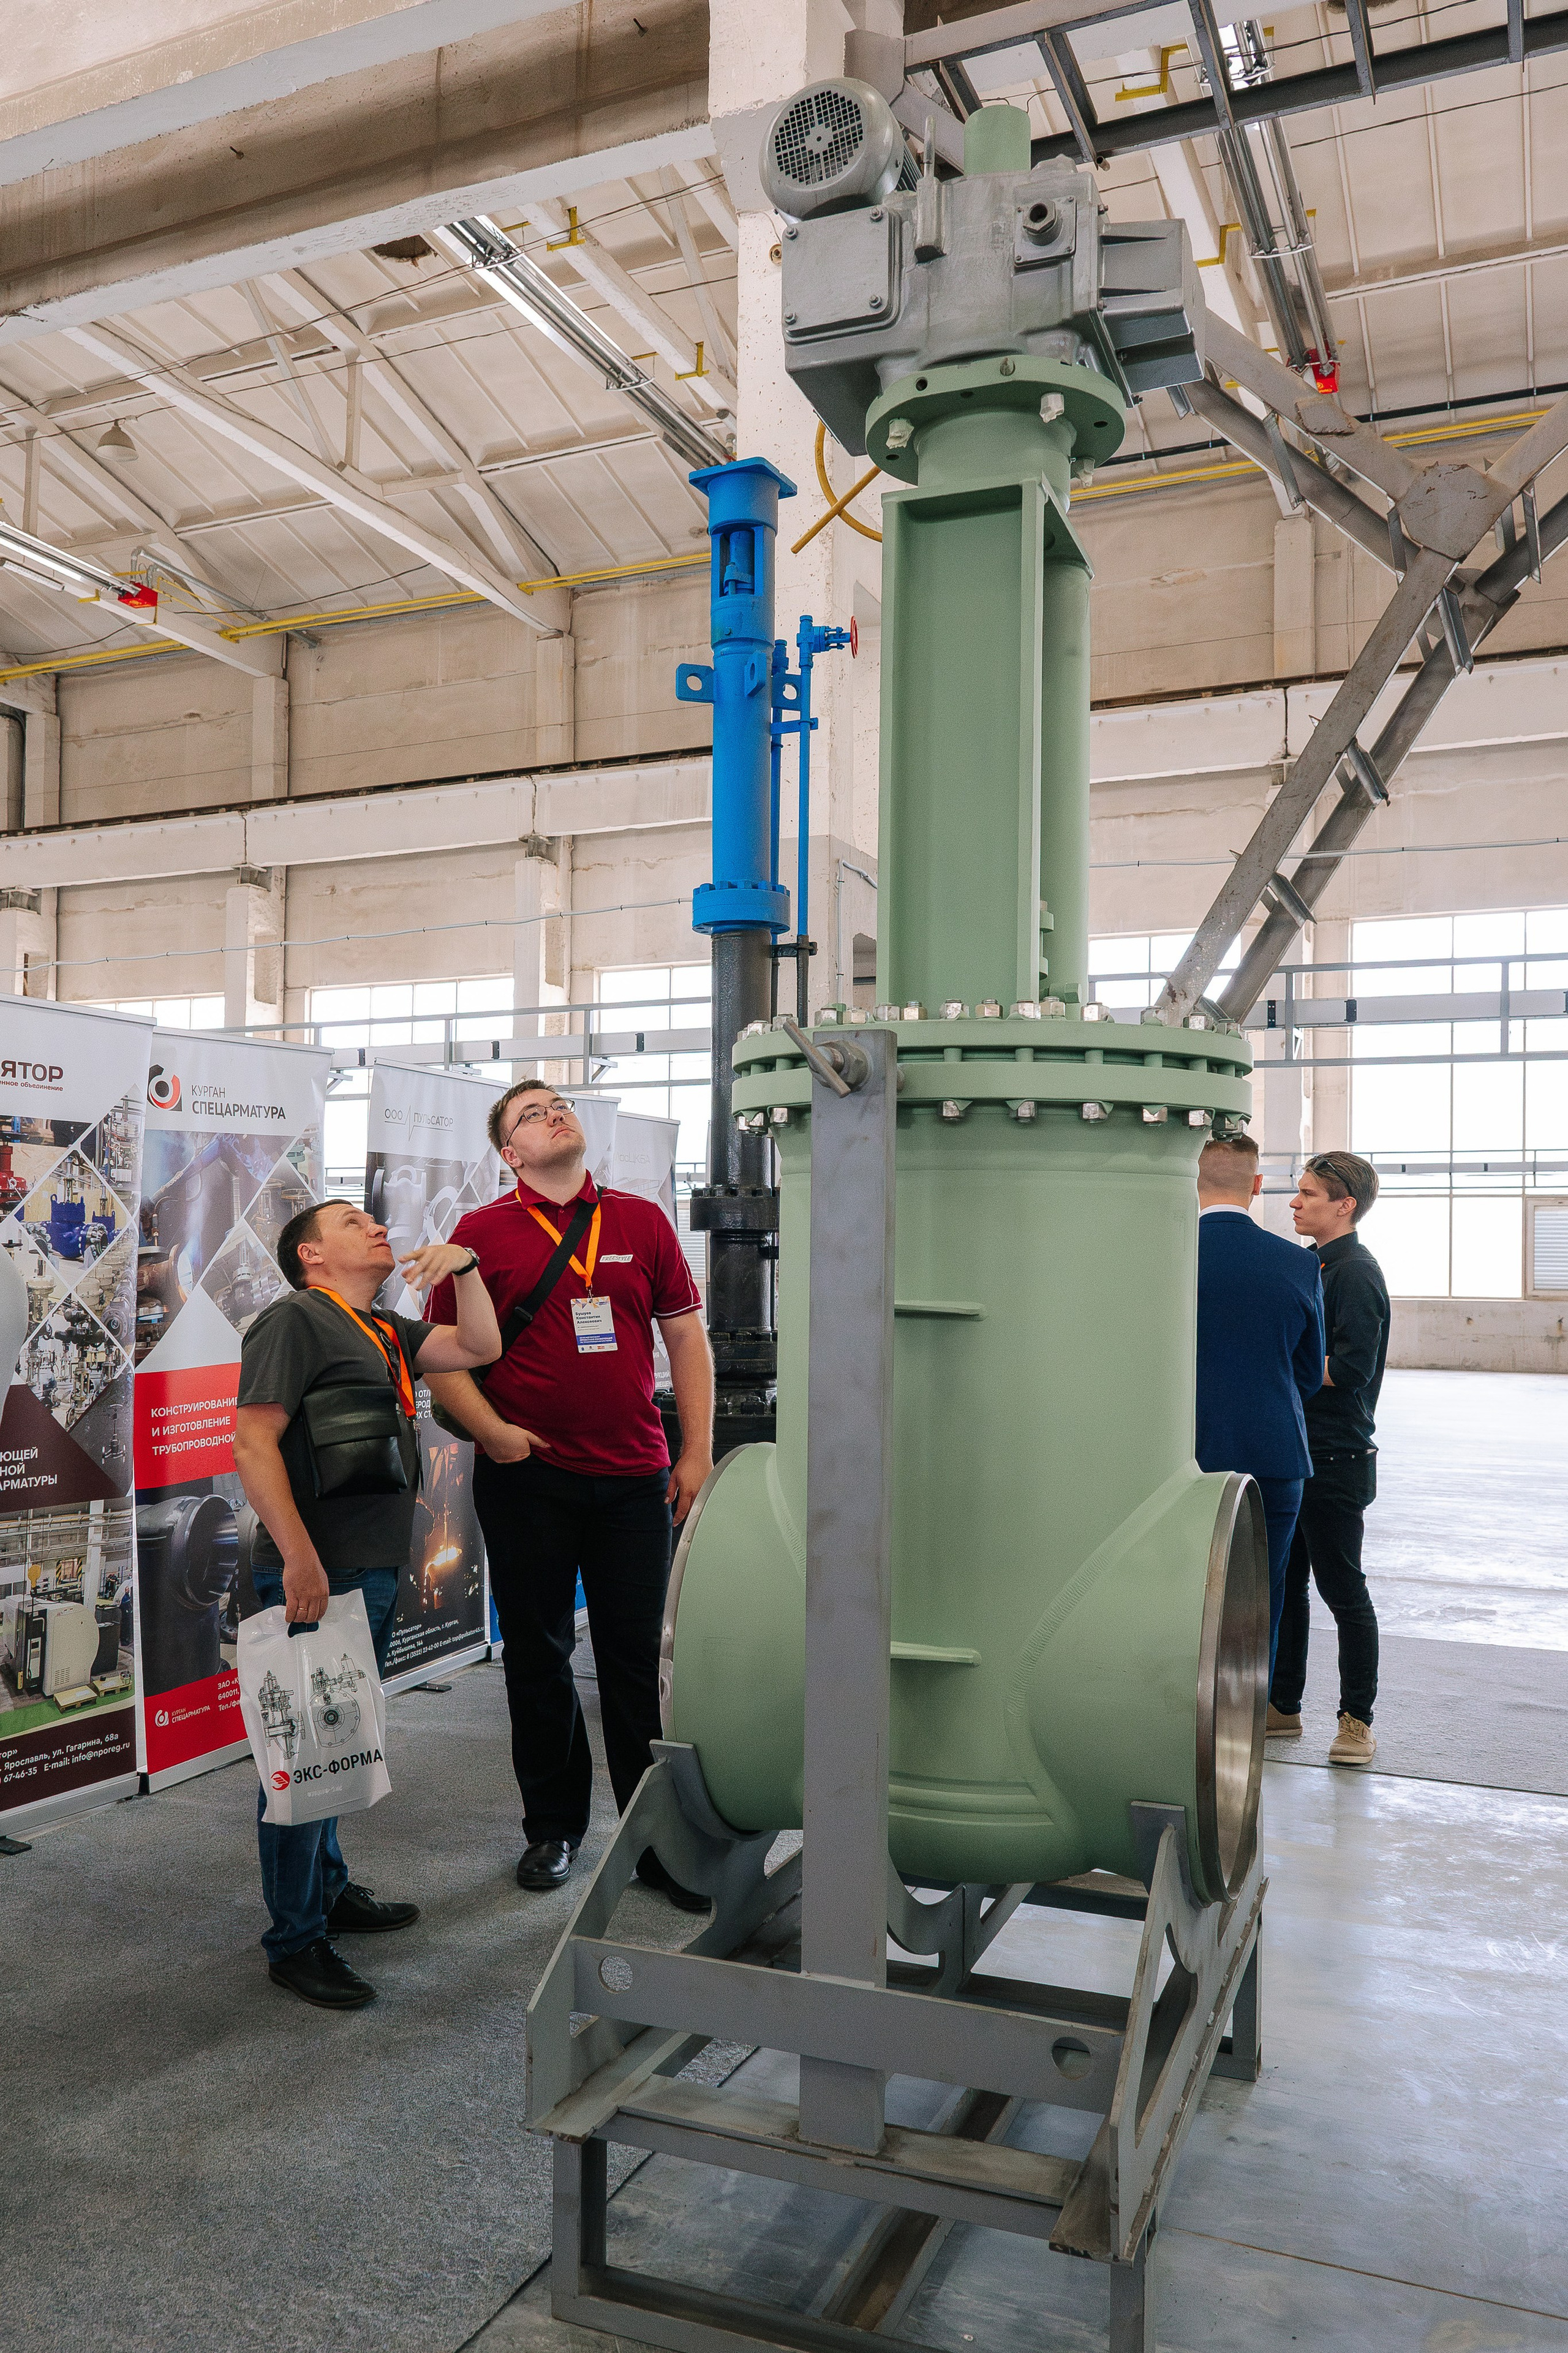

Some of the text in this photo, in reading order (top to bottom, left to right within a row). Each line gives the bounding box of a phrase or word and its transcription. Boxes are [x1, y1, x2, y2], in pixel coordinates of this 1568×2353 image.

[1, 1060, 64, 1082] ЯТОР
[20, 1082, 63, 1092] объединение
[191, 1084, 225, 1098] КУРГАН
[192, 1100, 286, 1120] СПЕЦАРМАТУРА
[385, 1108, 453, 1127] ООО ПУЛЬСАТОР
[151, 1416, 231, 1437] И ИЗГОТОВЛЕНИЕ
[152, 1431, 236, 1456] ТРУБОПРОВОДНОЙ
[0, 1462, 25, 1476] НОЙ
[402, 1631, 424, 1644] Курганская
[391, 1643, 416, 1656] Куйбышева,
[410, 1649, 423, 1659] (3522)
[217, 1680, 230, 1690] ЗАО
[217, 1688, 239, 1701] 640011,
[172, 1707, 186, 1717] КУРГАН
[172, 1705, 211, 1723] СПЕЦАРМАТУРА
[4, 1753, 50, 1770] Ярославль,
[52, 1750, 64, 1759] ул.
[66, 1738, 103, 1753] Гагарина,
[3, 1766, 37, 1783] 67-46-35
[43, 1757, 70, 1772] E-mail:
[72, 1742, 130, 1764] info@nporeg.ru
[293, 1748, 383, 1784] ЭКС-ФОРМА
